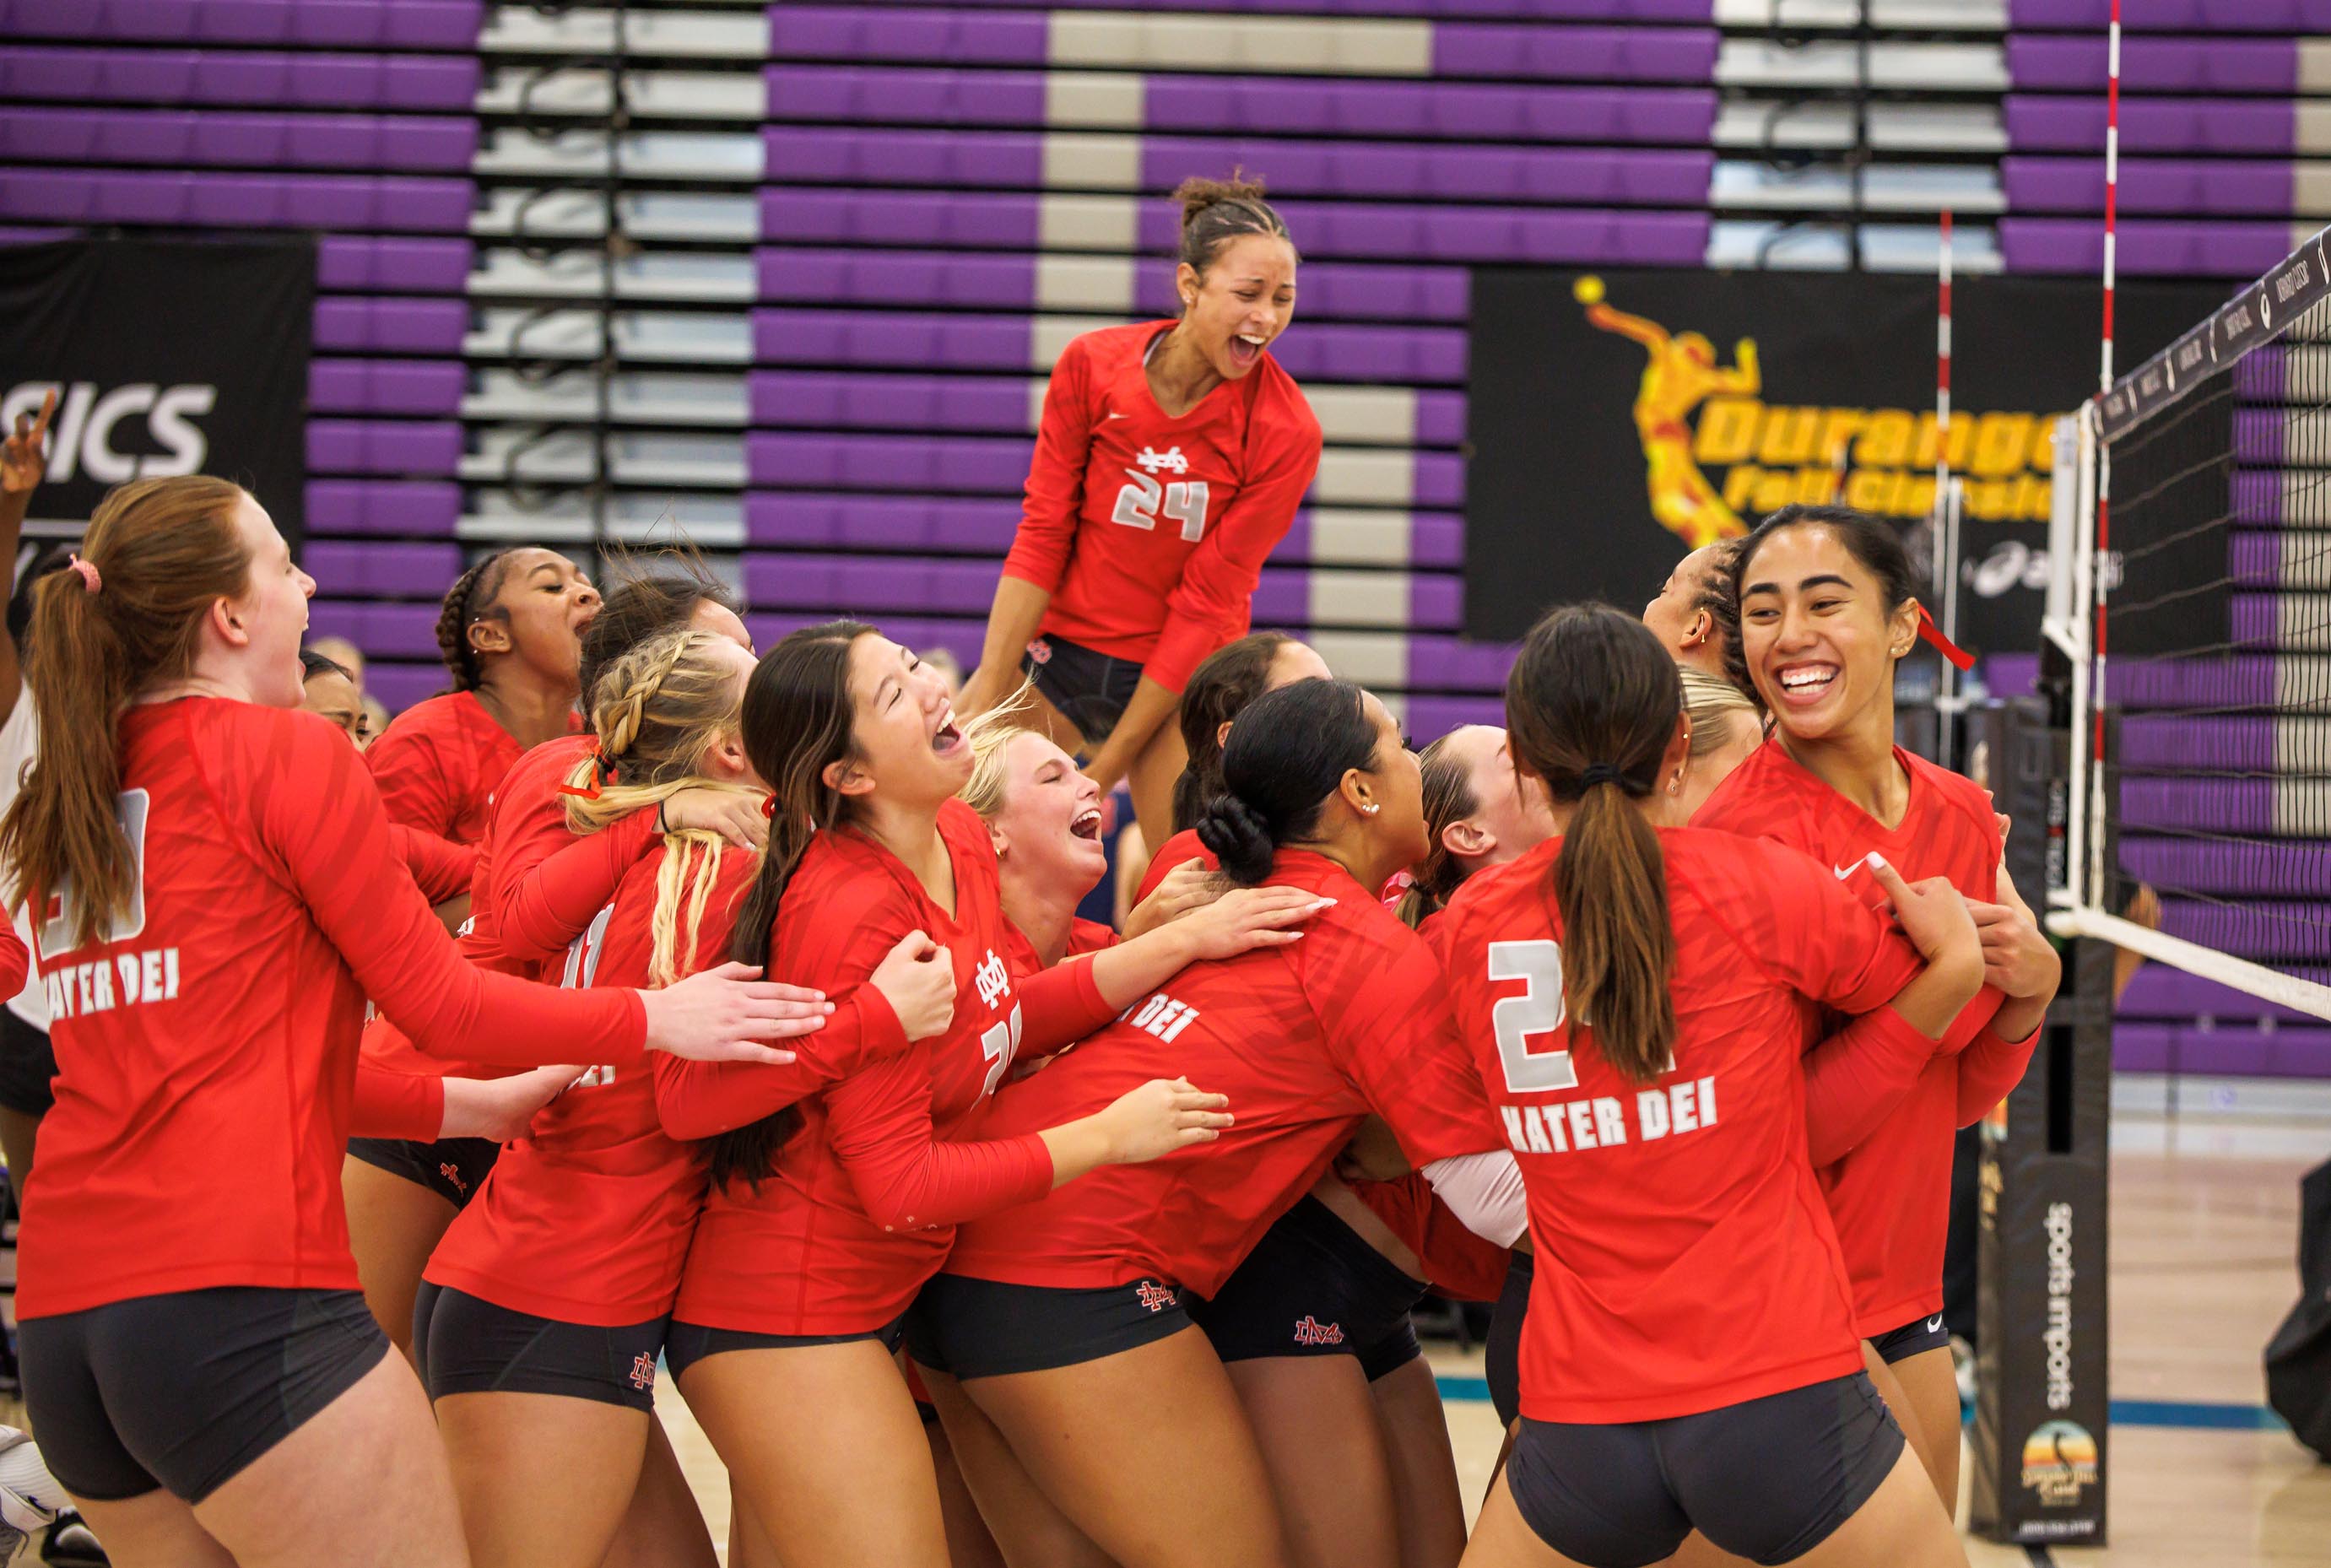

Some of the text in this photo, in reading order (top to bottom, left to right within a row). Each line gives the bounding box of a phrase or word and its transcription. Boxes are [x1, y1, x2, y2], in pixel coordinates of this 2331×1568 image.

[1111, 468, 1209, 543] 24
[42, 947, 180, 1021] ATER DEI
[1129, 992, 1200, 1044] DEI
[1636, 1075, 1717, 1141] DEI
[2043, 1202, 2074, 1410] sports imports
